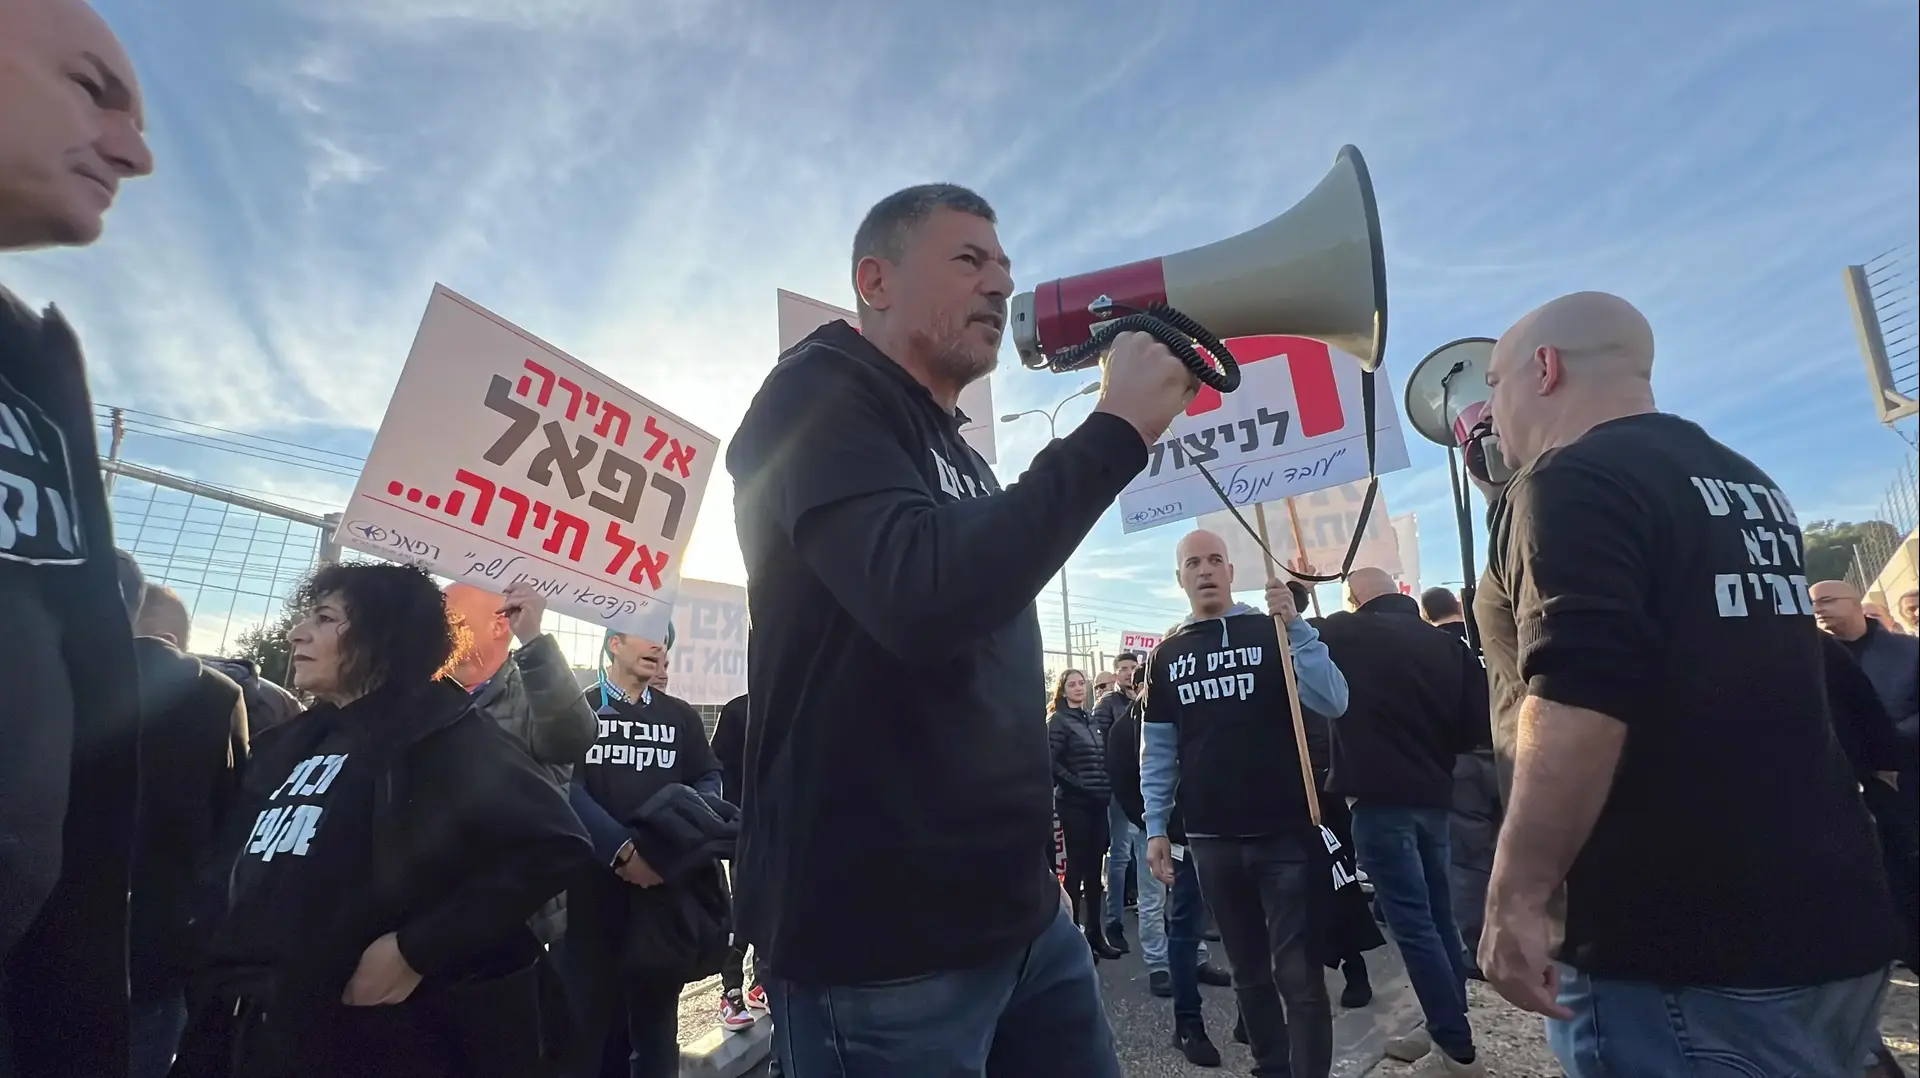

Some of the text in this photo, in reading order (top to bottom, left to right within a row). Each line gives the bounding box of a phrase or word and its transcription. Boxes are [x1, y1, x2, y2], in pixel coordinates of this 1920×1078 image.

[515, 358, 697, 478] אל תירה
[482, 373, 687, 541] רפאל
[1147, 501, 1183, 519] רפאל
[386, 468, 671, 591] אל תירה...
[388, 529, 440, 560] רפאל
[1740, 525, 1800, 568] ללא
[1715, 573, 1815, 618] סמים
[1168, 652, 1196, 682] ללא
[1207, 646, 1263, 673] שרביט
[1177, 672, 1255, 705] קסמים
[585, 744, 677, 772] שקופים
